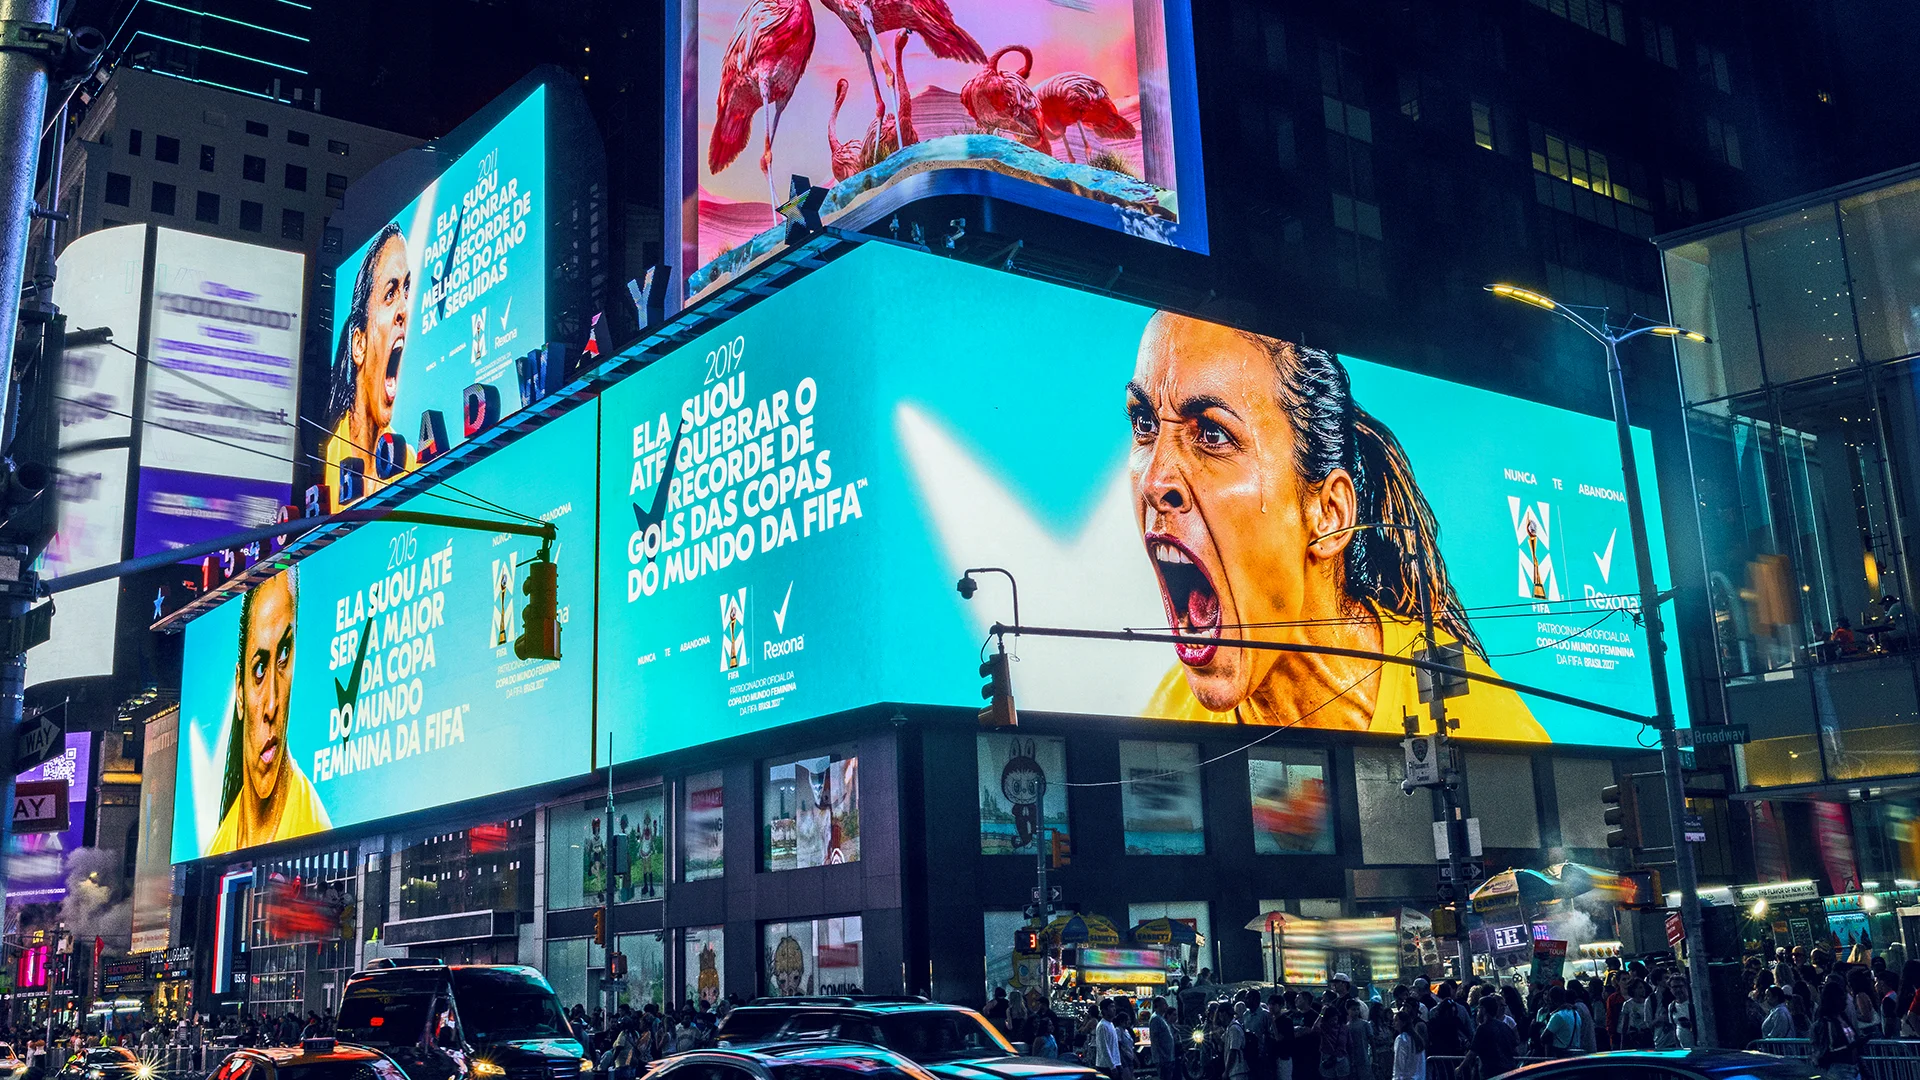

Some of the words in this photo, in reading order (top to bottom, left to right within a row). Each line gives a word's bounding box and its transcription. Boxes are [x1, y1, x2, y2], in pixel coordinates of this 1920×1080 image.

[477, 147, 498, 182] 2011
[437, 204, 459, 237] ELA
[462, 169, 498, 215] SUOU
[424, 229, 455, 268] PARA
[461, 178, 518, 239] HONRAR
[433, 260, 444, 281] O
[452, 207, 511, 268] RECORDE
[513, 190, 531, 223] DE
[421, 261, 470, 314] MELHOR
[472, 245, 492, 276] DO
[493, 220, 526, 261] ANO
[421, 307, 438, 335] 5X
[444, 257, 508, 319] SEGUIDAS
[494, 327, 519, 349] Rexona
[703, 336, 745, 386] 2019
[632, 412, 671, 459] ELA
[680, 371, 745, 434] SUOU
[629, 441, 667, 496] ATÉ
[674, 389, 789, 473] QUEBRAR
[795, 376, 817, 415] O
[667, 433, 775, 513] RECORDE
[781, 415, 815, 464] DE
[1503, 468, 1538, 486] NUNCA
[1552, 477, 1563, 491] TE
[1578, 483, 1626, 503] ABANDONA
[491, 532, 513, 547] NUNCA
[538, 502, 573, 524] ABANDONA
[627, 513, 685, 565] GOLS
[690, 490, 738, 541] DAS
[742, 449, 832, 518] COPAS
[386, 526, 419, 571] 2015
[627, 561, 659, 603] DO
[663, 523, 755, 590] MUNDO
[760, 507, 798, 553] DA
[335, 589, 365, 632] ELA
[367, 563, 416, 618] SUOU
[418, 538, 453, 595] ATÉ
[1583, 584, 1640, 614] Rexona
[1531, 601, 1551, 614] FIFA
[328, 629, 359, 671] SER
[366, 619, 380, 656] A
[382, 590, 445, 650] MAIOR
[763, 634, 805, 661] Rexona
[1536, 637, 1559, 650] COPA
[1559, 640, 1571, 651] DO
[1571, 641, 1600, 654] MUNDO
[1600, 645, 1636, 659] FEMININA
[1537, 622, 1593, 639] PATROCINADOR
[1593, 629, 1620, 643] OFICIAL
[1620, 633, 1631, 644] DA
[360, 653, 384, 694] DA
[386, 632, 436, 684] COPA
[637, 652, 657, 666] NUNCA
[664, 648, 671, 657] TE
[680, 636, 711, 653] ABANDONA
[1556, 654, 1568, 665] DA
[1568, 656, 1583, 667] FIFA
[727, 671, 740, 681] FIFA
[730, 677, 767, 696] PATROCINADOR
[767, 673, 787, 685] OFICIAL
[786, 671, 795, 680] DA
[328, 702, 353, 742] DO
[354, 677, 423, 733] MUNDO
[727, 696, 742, 708] COPA
[742, 694, 750, 704] DO
[750, 689, 771, 702] MUNDO
[771, 682, 797, 696] FEMININA
[739, 707, 748, 717] DA
[747, 704, 758, 715] FIFA
[25, 725, 52, 754] WAY
[313, 728, 393, 784] FEMININA
[395, 719, 421, 761] DA
[1694, 728, 1746, 745] Broadway
[13, 797, 46, 818] AY
[1029, 933, 1037, 949] 3
[1549, 948, 1566, 956] TOUR
